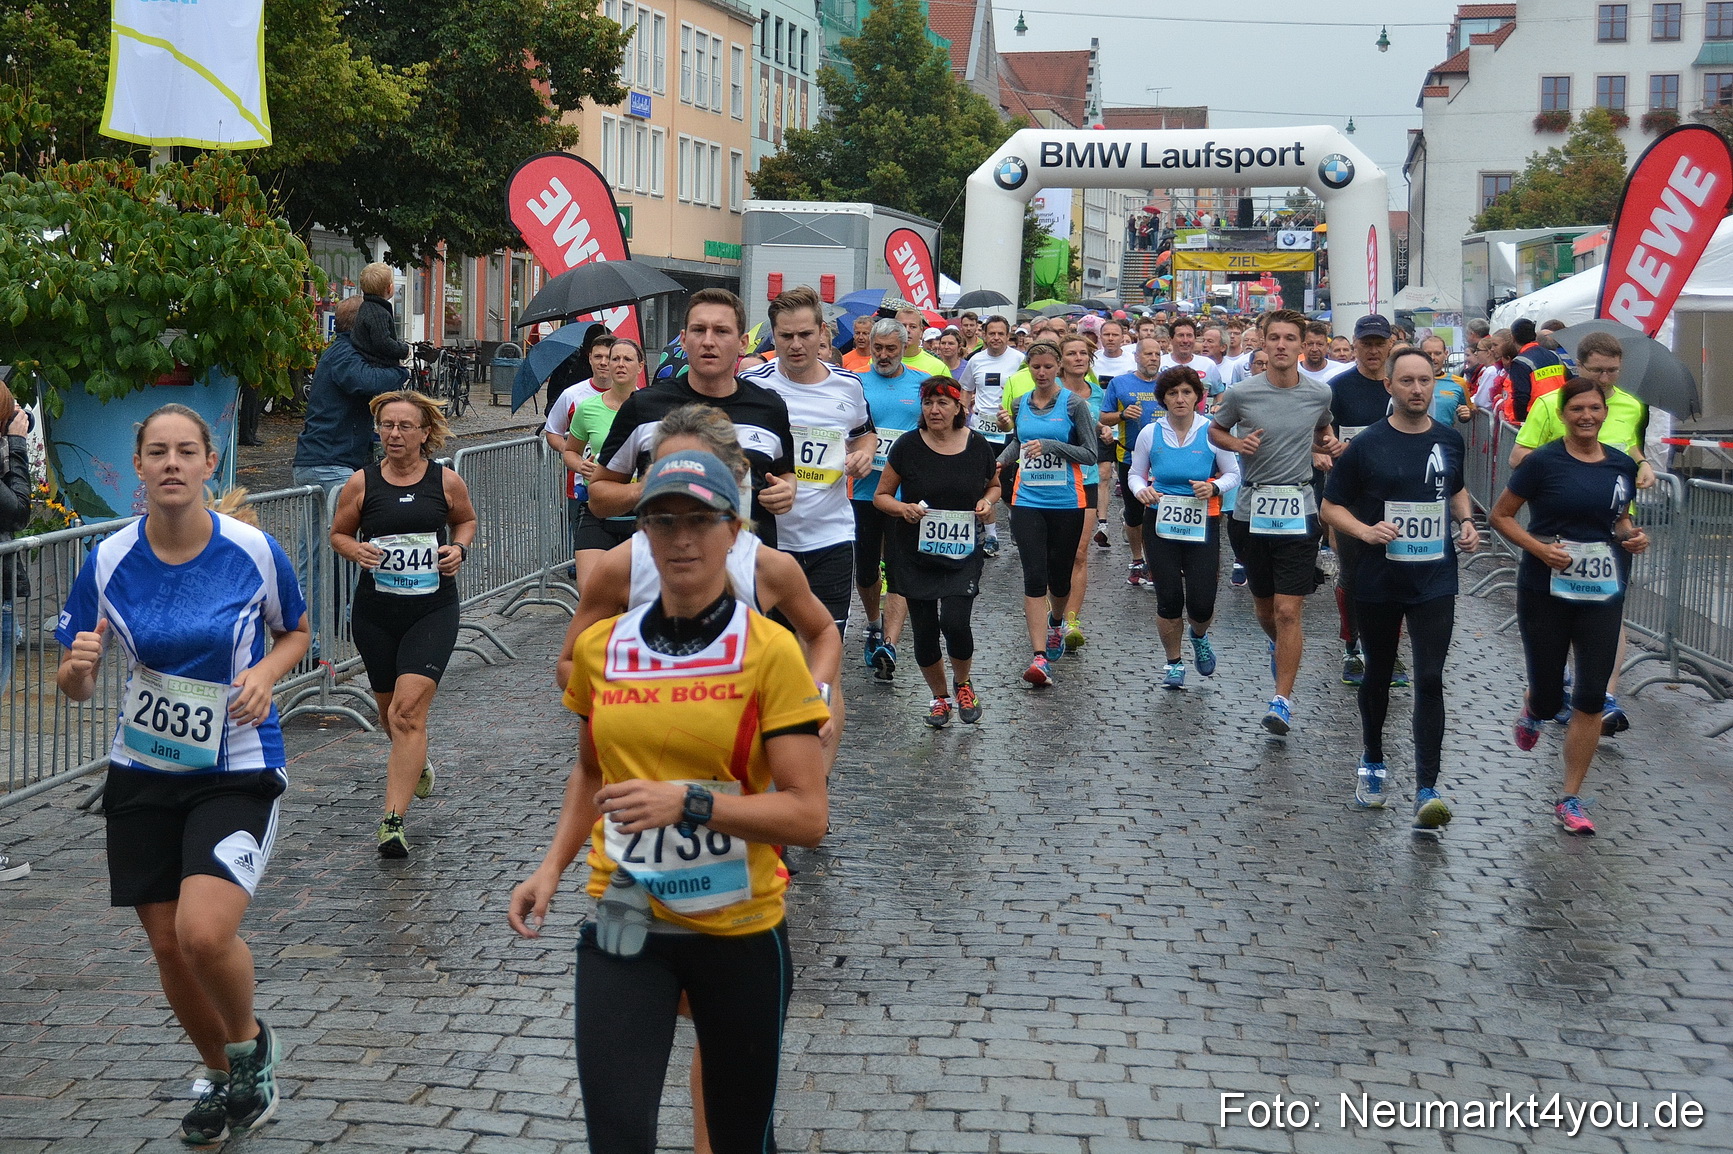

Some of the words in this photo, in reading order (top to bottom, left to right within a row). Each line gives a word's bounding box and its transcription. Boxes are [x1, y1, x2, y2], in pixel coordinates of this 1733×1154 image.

[1040, 142, 1132, 168] BMW
[1141, 141, 1305, 173] Laufsport
[1321, 154, 1353, 167] BMW
[1608, 155, 1717, 331] REWE
[1228, 256, 1260, 267] ZIEL
[978, 420, 1003, 433] 255
[801, 441, 828, 465] 67
[876, 438, 894, 455] 27
[660, 460, 706, 473] MUSTO
[1024, 453, 1062, 469] 2584
[796, 468, 825, 481] Stefan
[1162, 505, 1202, 525] 2585
[1257, 498, 1300, 516] 2778
[925, 521, 970, 541] 3044
[1170, 526, 1191, 535] Margit
[1271, 520, 1284, 528] Nic
[1391, 516, 1441, 538] 2601
[923, 541, 966, 554] SIGRID
[1407, 545, 1429, 555] Ryan
[380, 547, 433, 571] 2344
[1570, 582, 1602, 593] Verena
[167, 678, 218, 698] BOCK
[602, 687, 660, 705] MAX
[671, 681, 744, 702] BÖGL
[133, 690, 214, 742] 2633
[151, 741, 180, 760] Jana
[234, 859, 255, 874] adidas
[644, 875, 712, 895] Yvonne
